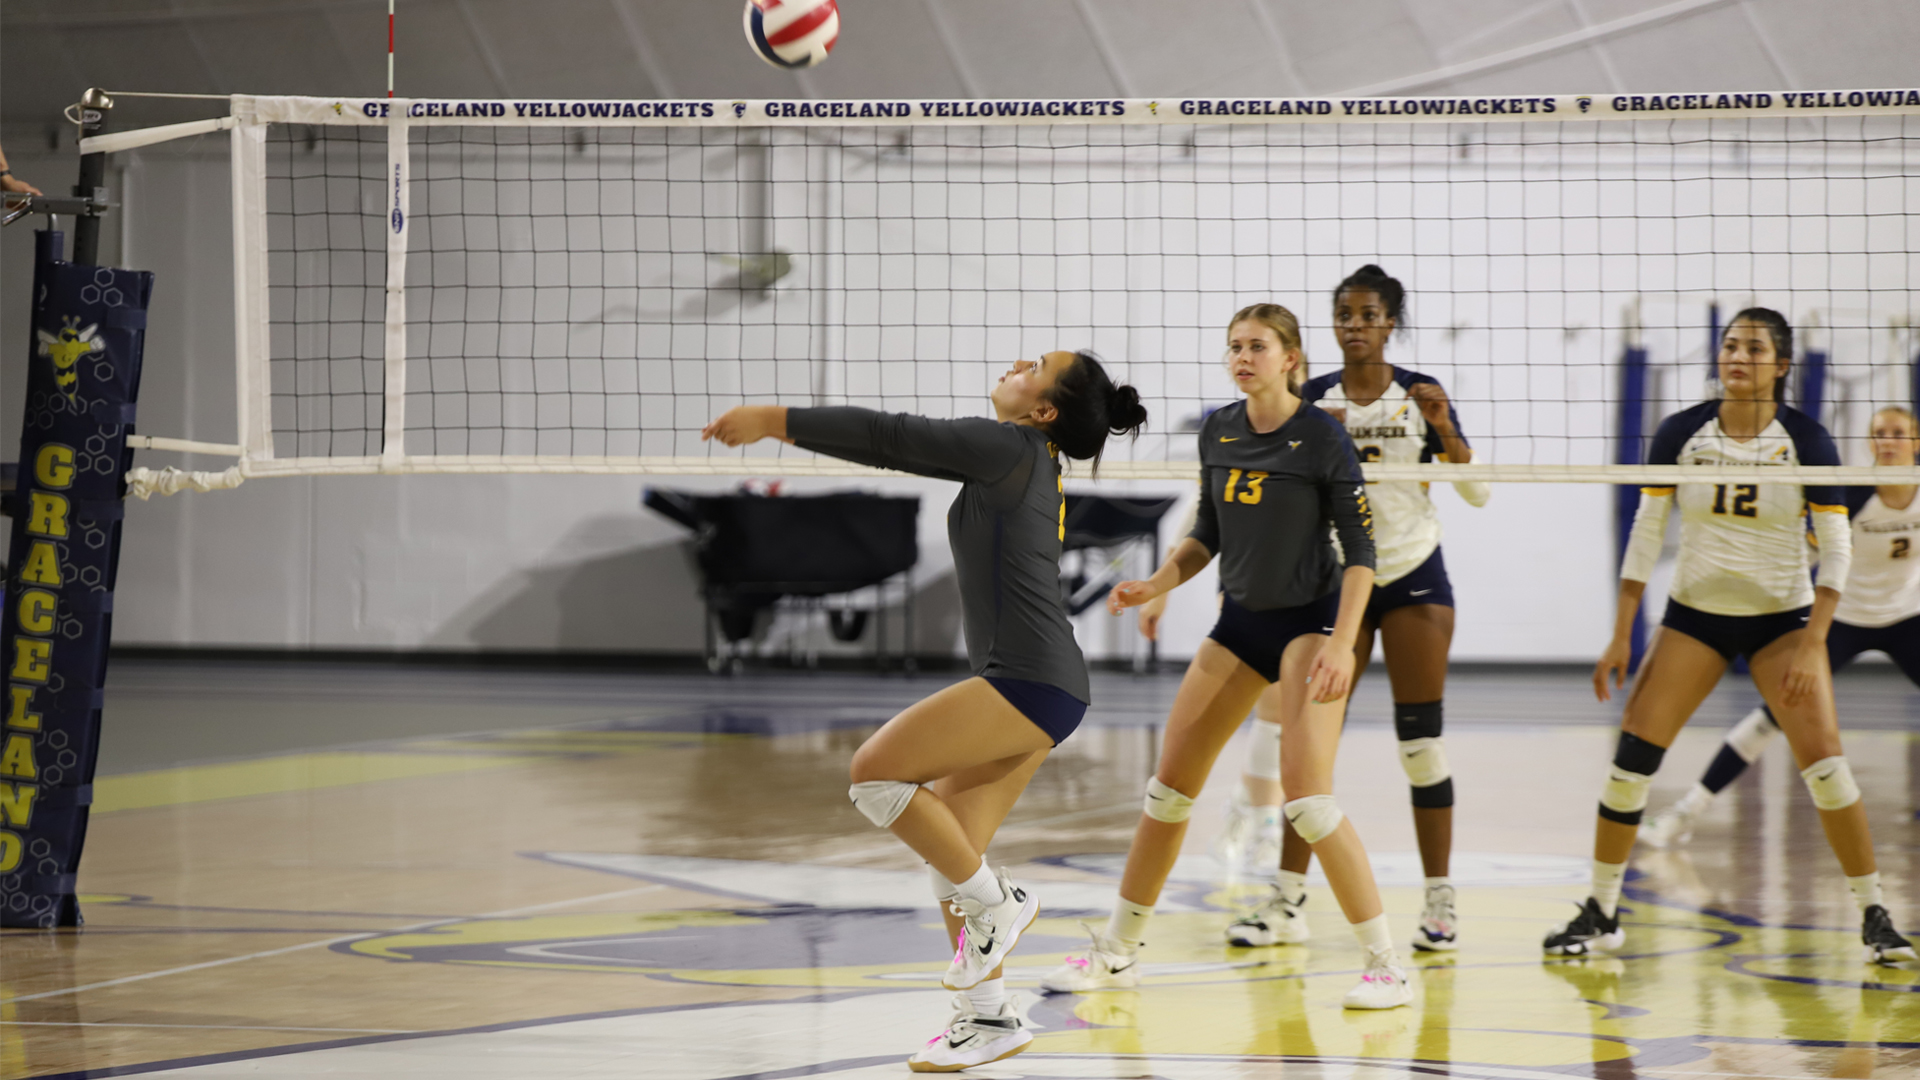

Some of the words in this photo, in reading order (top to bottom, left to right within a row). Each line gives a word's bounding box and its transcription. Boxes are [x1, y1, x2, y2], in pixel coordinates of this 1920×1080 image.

[514, 102, 714, 118] YELLOWJACKETS
[765, 102, 911, 118] GRACELAND
[919, 101, 1125, 118] YELLOWJACKETS
[1180, 100, 1332, 116] GRACELAND
[1341, 97, 1556, 115] YELLOWJACKETS
[1612, 93, 1772, 112] GRACELAND
[1223, 468, 1270, 505] 13
[1712, 484, 1758, 518] 12
[1890, 538, 1911, 560] 2
[0, 442, 77, 873] GRACELAND
